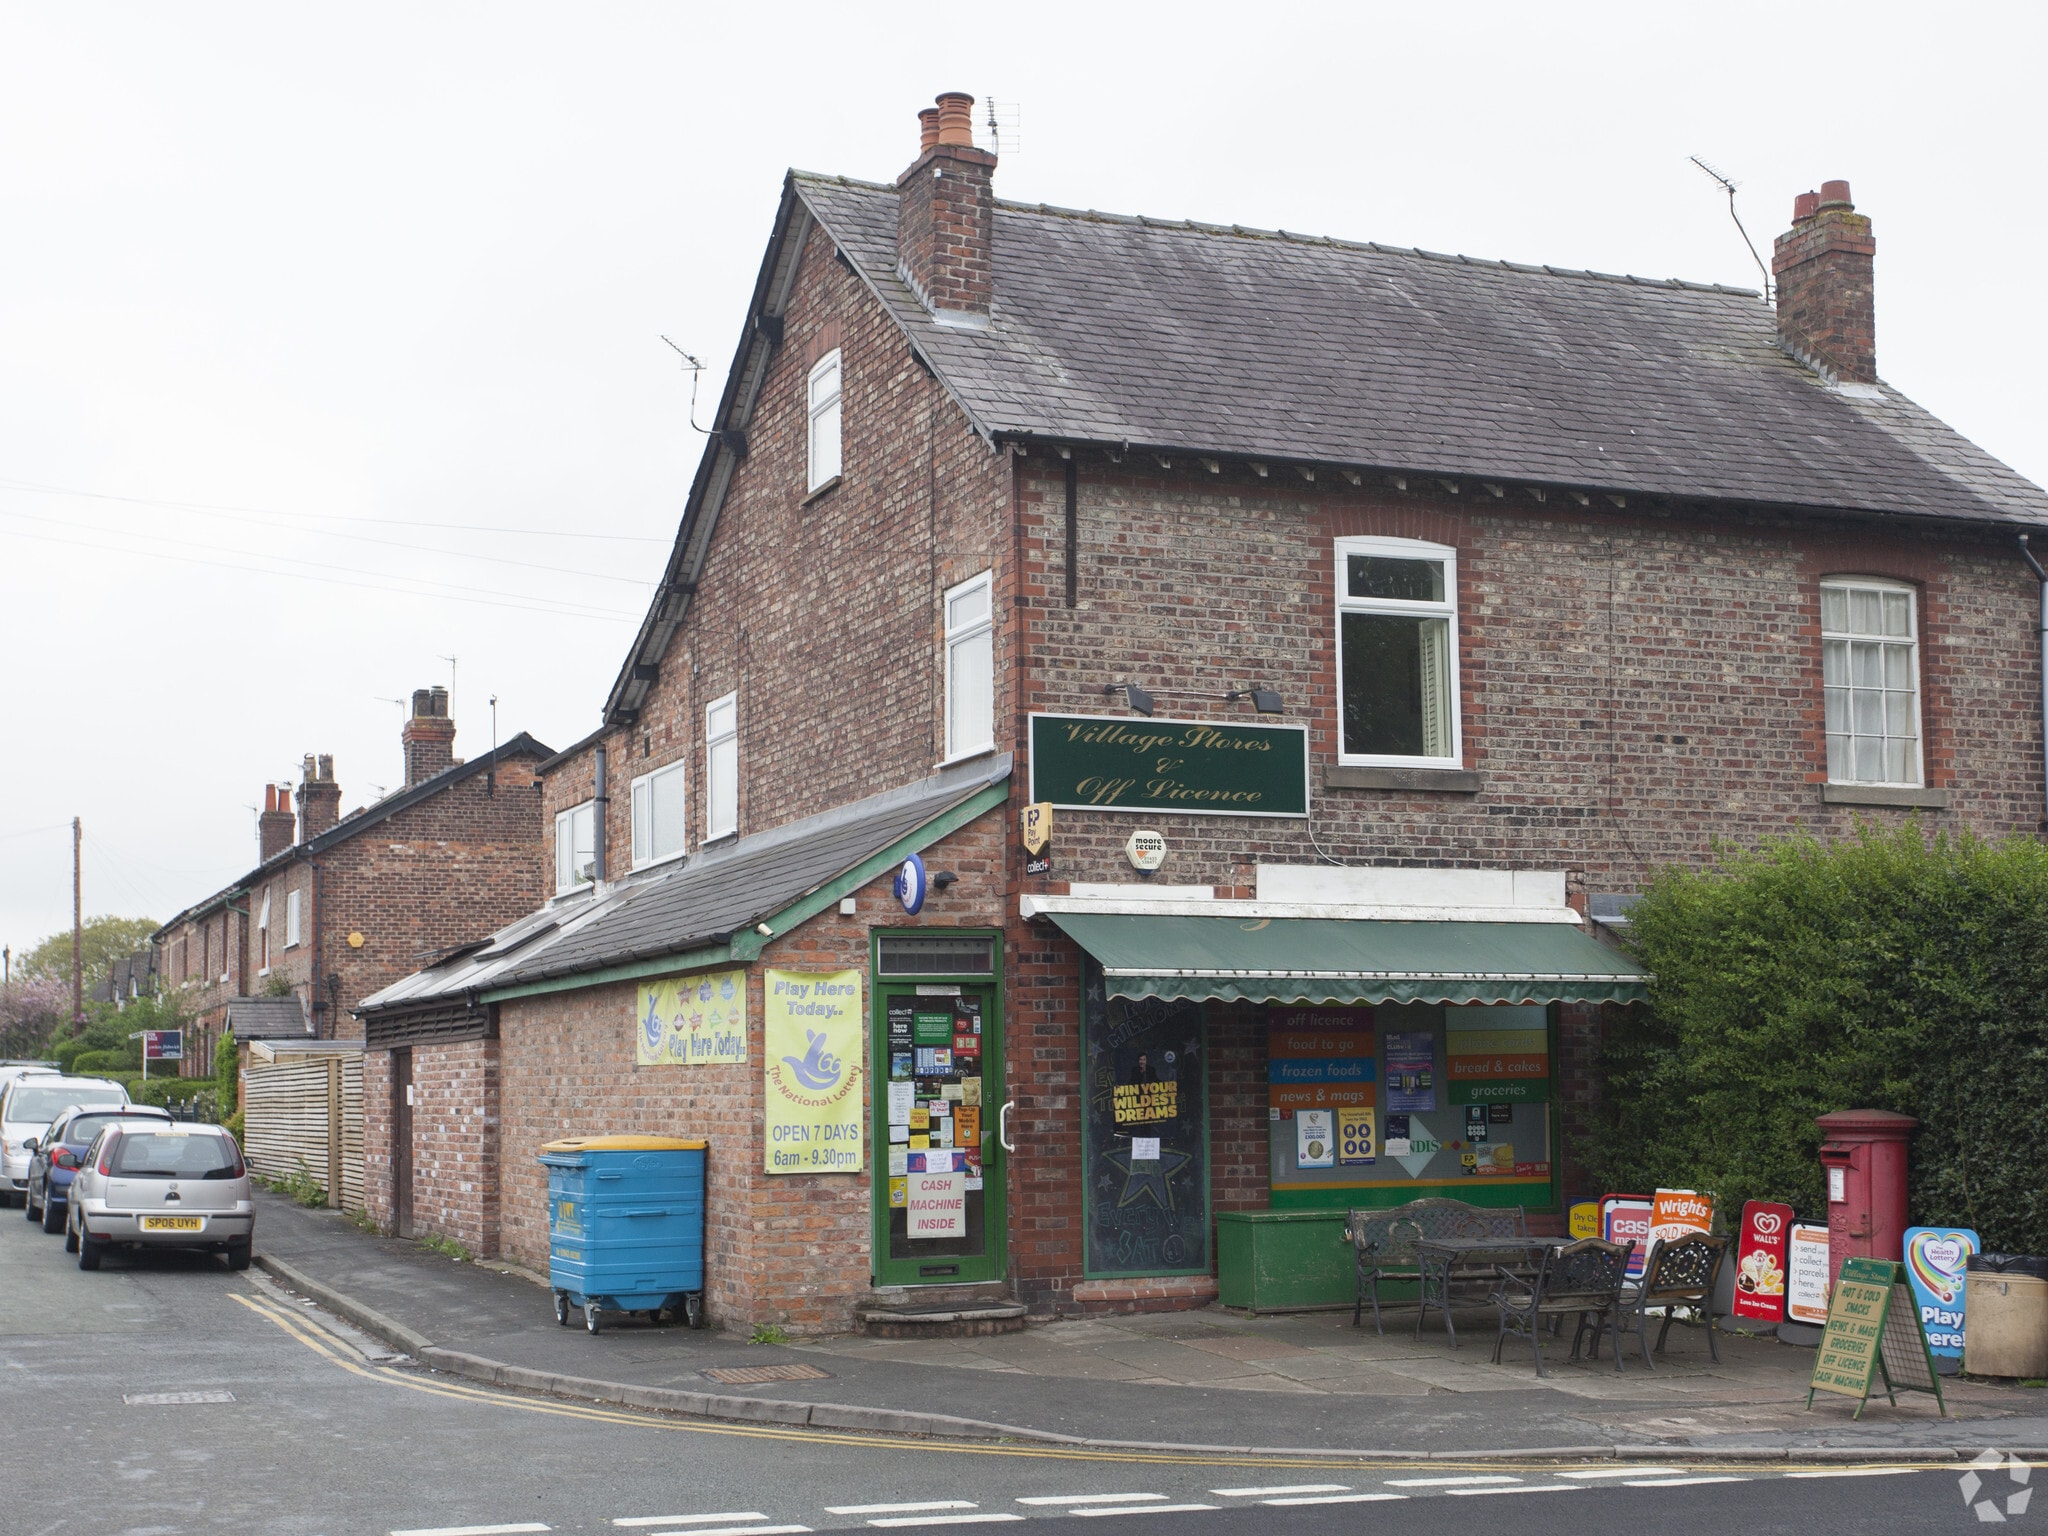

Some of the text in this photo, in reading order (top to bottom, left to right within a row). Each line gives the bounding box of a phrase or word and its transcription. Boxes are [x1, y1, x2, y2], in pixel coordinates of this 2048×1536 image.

[1062, 723, 1272, 754] Village Stores
[1156, 757, 1184, 774] &
[1076, 776, 1262, 805] Off Licence
[1028, 828, 1036, 837] Pay
[1028, 837, 1041, 846] Point
[1135, 843, 1162, 851] secure
[774, 981, 856, 999] Play Here
[787, 1001, 844, 1019] Today..
[1287, 1013, 1354, 1026] off licence
[669, 1031, 746, 1063] Play Here Today..
[1288, 1037, 1354, 1053] food to go
[1282, 1063, 1362, 1077] frozen foods
[1455, 1060, 1541, 1073] bread & cakes
[769, 1065, 861, 1107] The National Lottery
[1113, 1081, 1178, 1096] WIN YOUR
[1471, 1083, 1527, 1100] groceries
[1113, 1093, 1178, 1110] WILDEST
[1280, 1088, 1365, 1104] news & mags
[1114, 1105, 1178, 1123] DREAMS
[773, 1124, 858, 1142] OPEN 7 DAYS
[774, 1149, 800, 1166] 6am
[811, 1148, 856, 1169] 9.30pm
[921, 1180, 952, 1191] CASH
[910, 1199, 963, 1210] MACHINE
[1659, 1198, 1708, 1217] Wrights
[148, 1218, 198, 1228] SP06 UYH
[917, 1218, 956, 1230] INSIDE
[1574, 1213, 1585, 1222] Dry
[1577, 1224, 1596, 1233] taken
[1655, 1226, 1679, 1240] SOLD
[1753, 1233, 1778, 1245] WALL'S
[1800, 1244, 1817, 1254] send
[1930, 1248, 1955, 1257] Health
[1799, 1256, 1822, 1267] collect
[1929, 1254, 1955, 1263] Lottery
[1799, 1268, 1825, 1281] parcels
[1845, 1268, 1888, 1282] Village Store
[1841, 1286, 1881, 1302] HOT & COLD
[1740, 1298, 1752, 1306] Love
[1760, 1302, 1778, 1311] Cream
[1844, 1302, 1871, 1316] SNACKS
[1921, 1306, 1965, 1331] Play
[1828, 1319, 1878, 1338] NEWS & MAGS
[1830, 1337, 1868, 1353] GROCERIES
[1823, 1353, 1867, 1373] OFF LICENCE
[1814, 1370, 1866, 1391] CASH MACHINE
